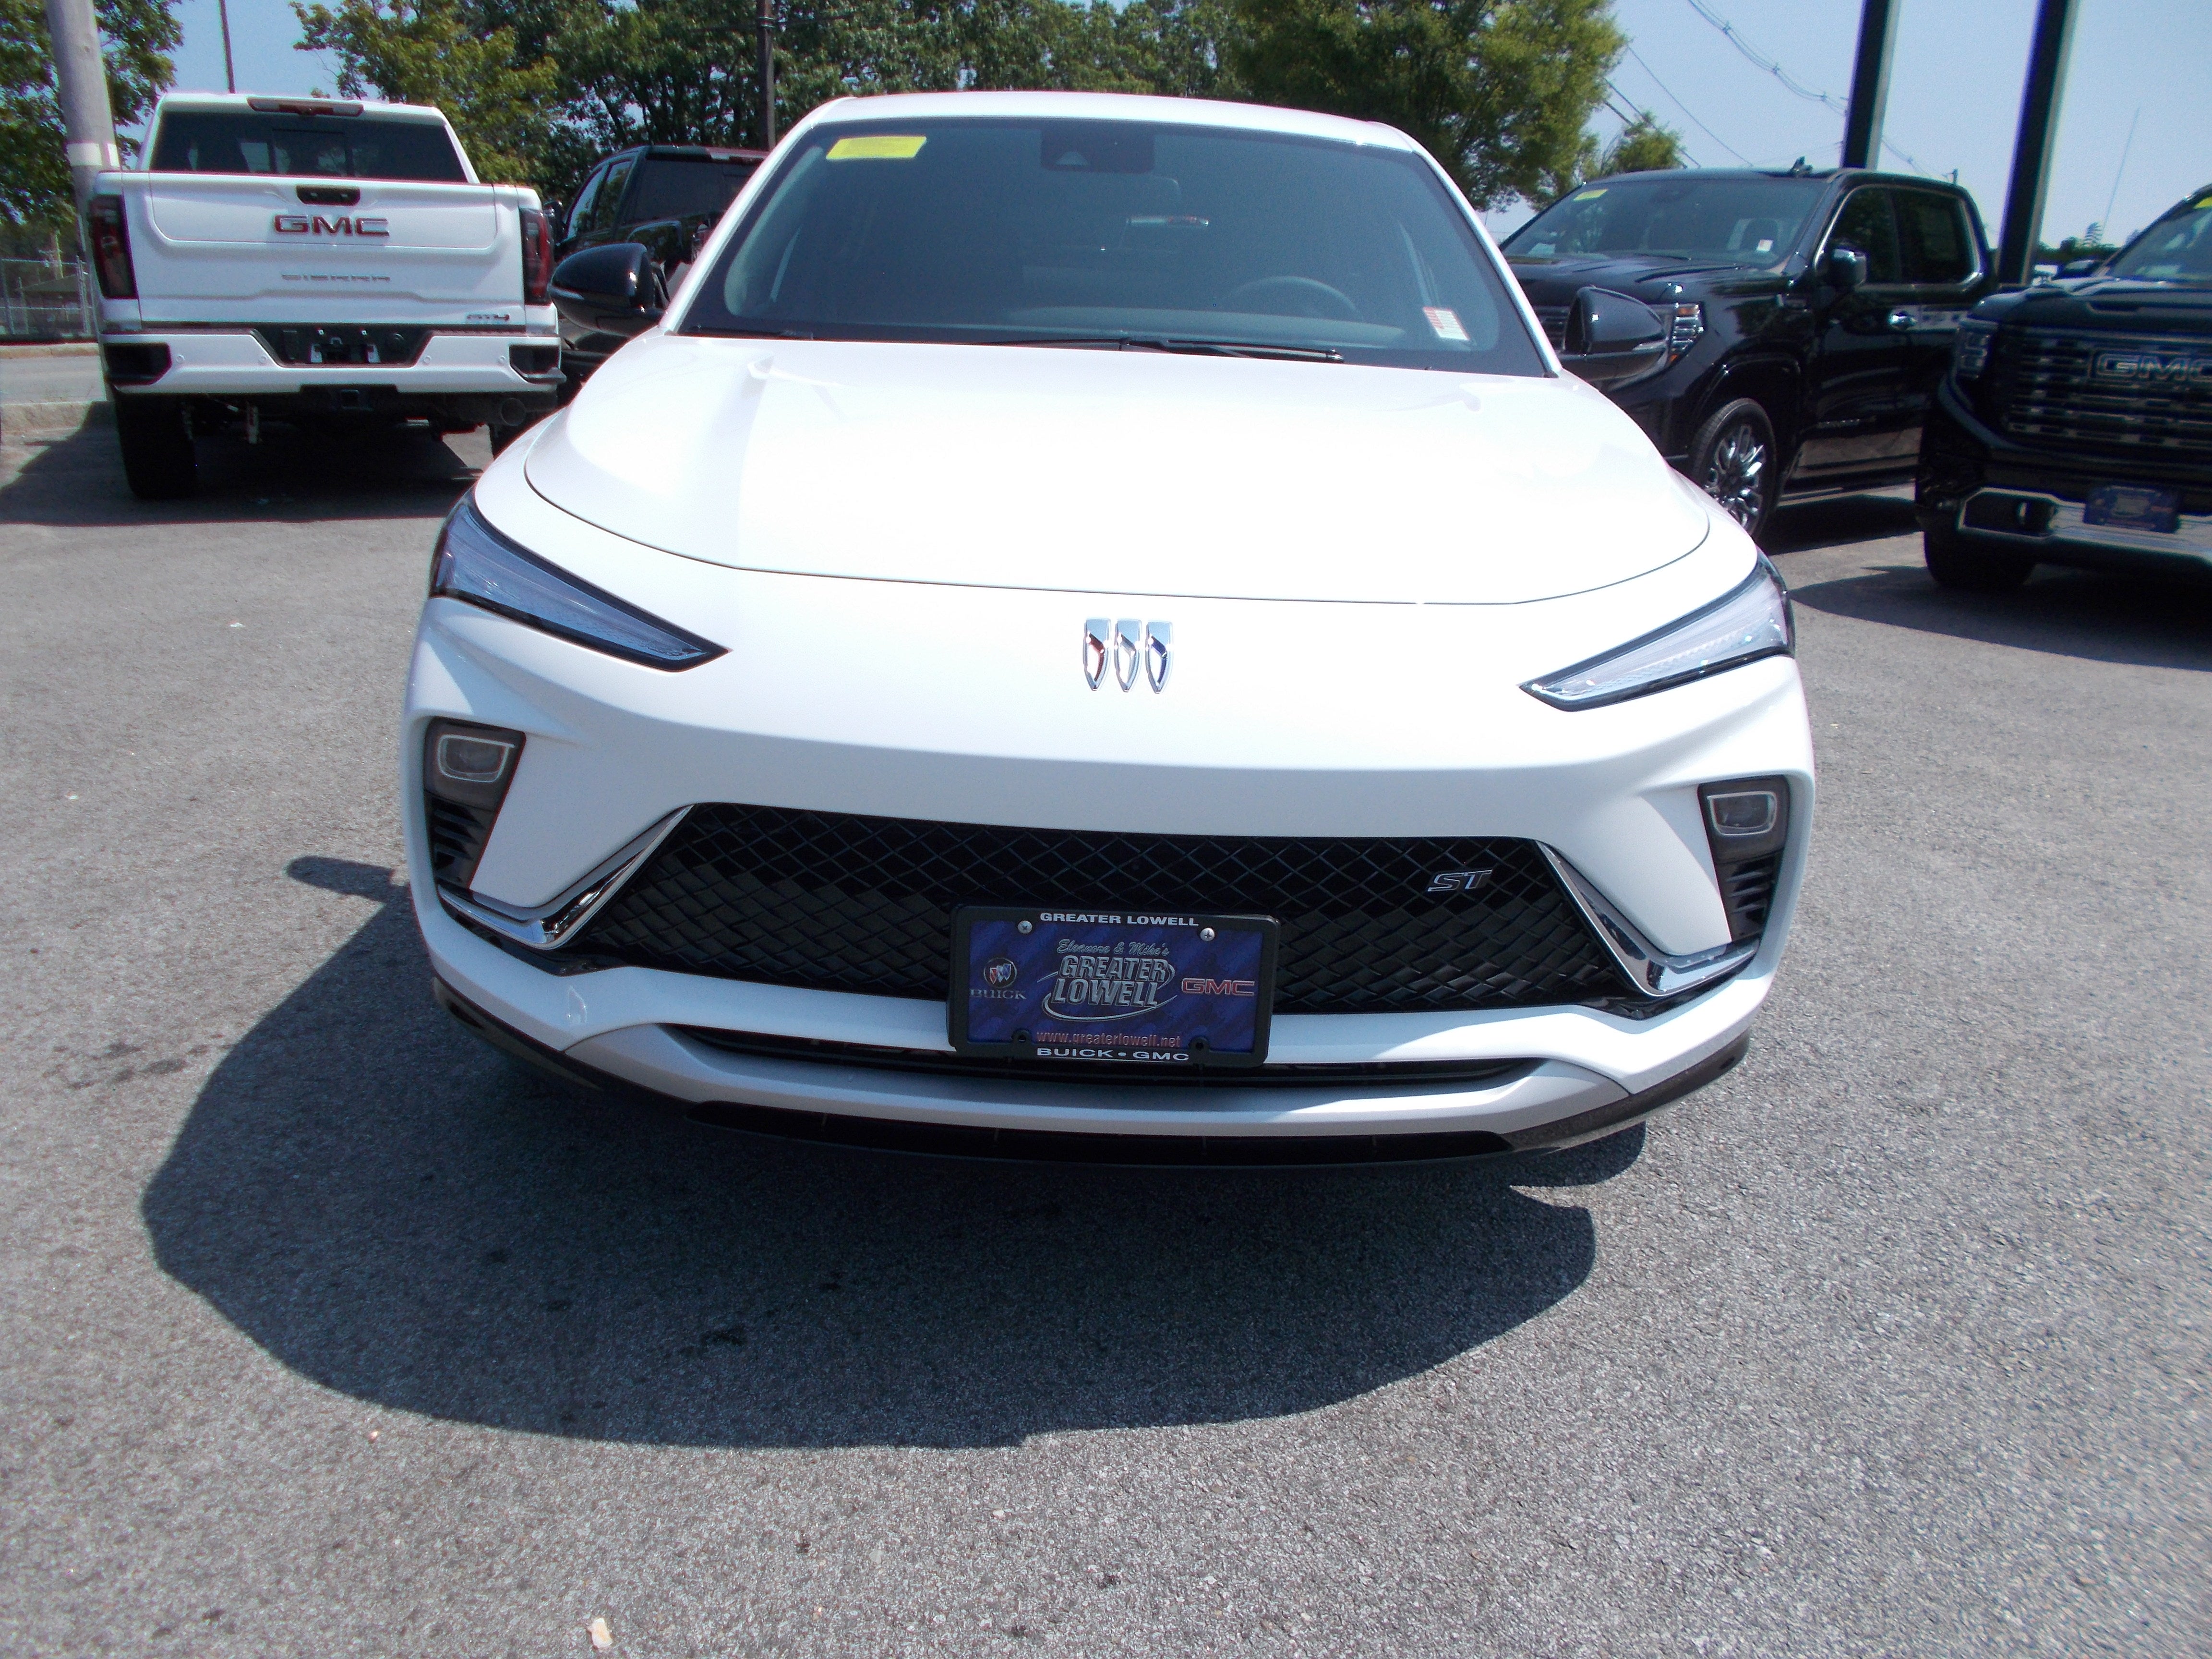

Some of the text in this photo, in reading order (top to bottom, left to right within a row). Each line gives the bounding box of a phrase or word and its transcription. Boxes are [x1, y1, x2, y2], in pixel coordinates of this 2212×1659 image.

[274, 215, 390, 237] GMC
[1427, 869, 1493, 892] ST
[1040, 913, 1199, 926] GREATER LOWELL
[1113, 941, 1125, 954] &
[1129, 941, 1170, 956] Mike's
[1059, 955, 1171, 983] GREATER
[969, 989, 1027, 999] BUICK
[1050, 978, 1158, 1008] LOWELL
[1181, 977, 1255, 997] GMC
[1036, 1032, 1181, 1047] www.greaterlowell.net
